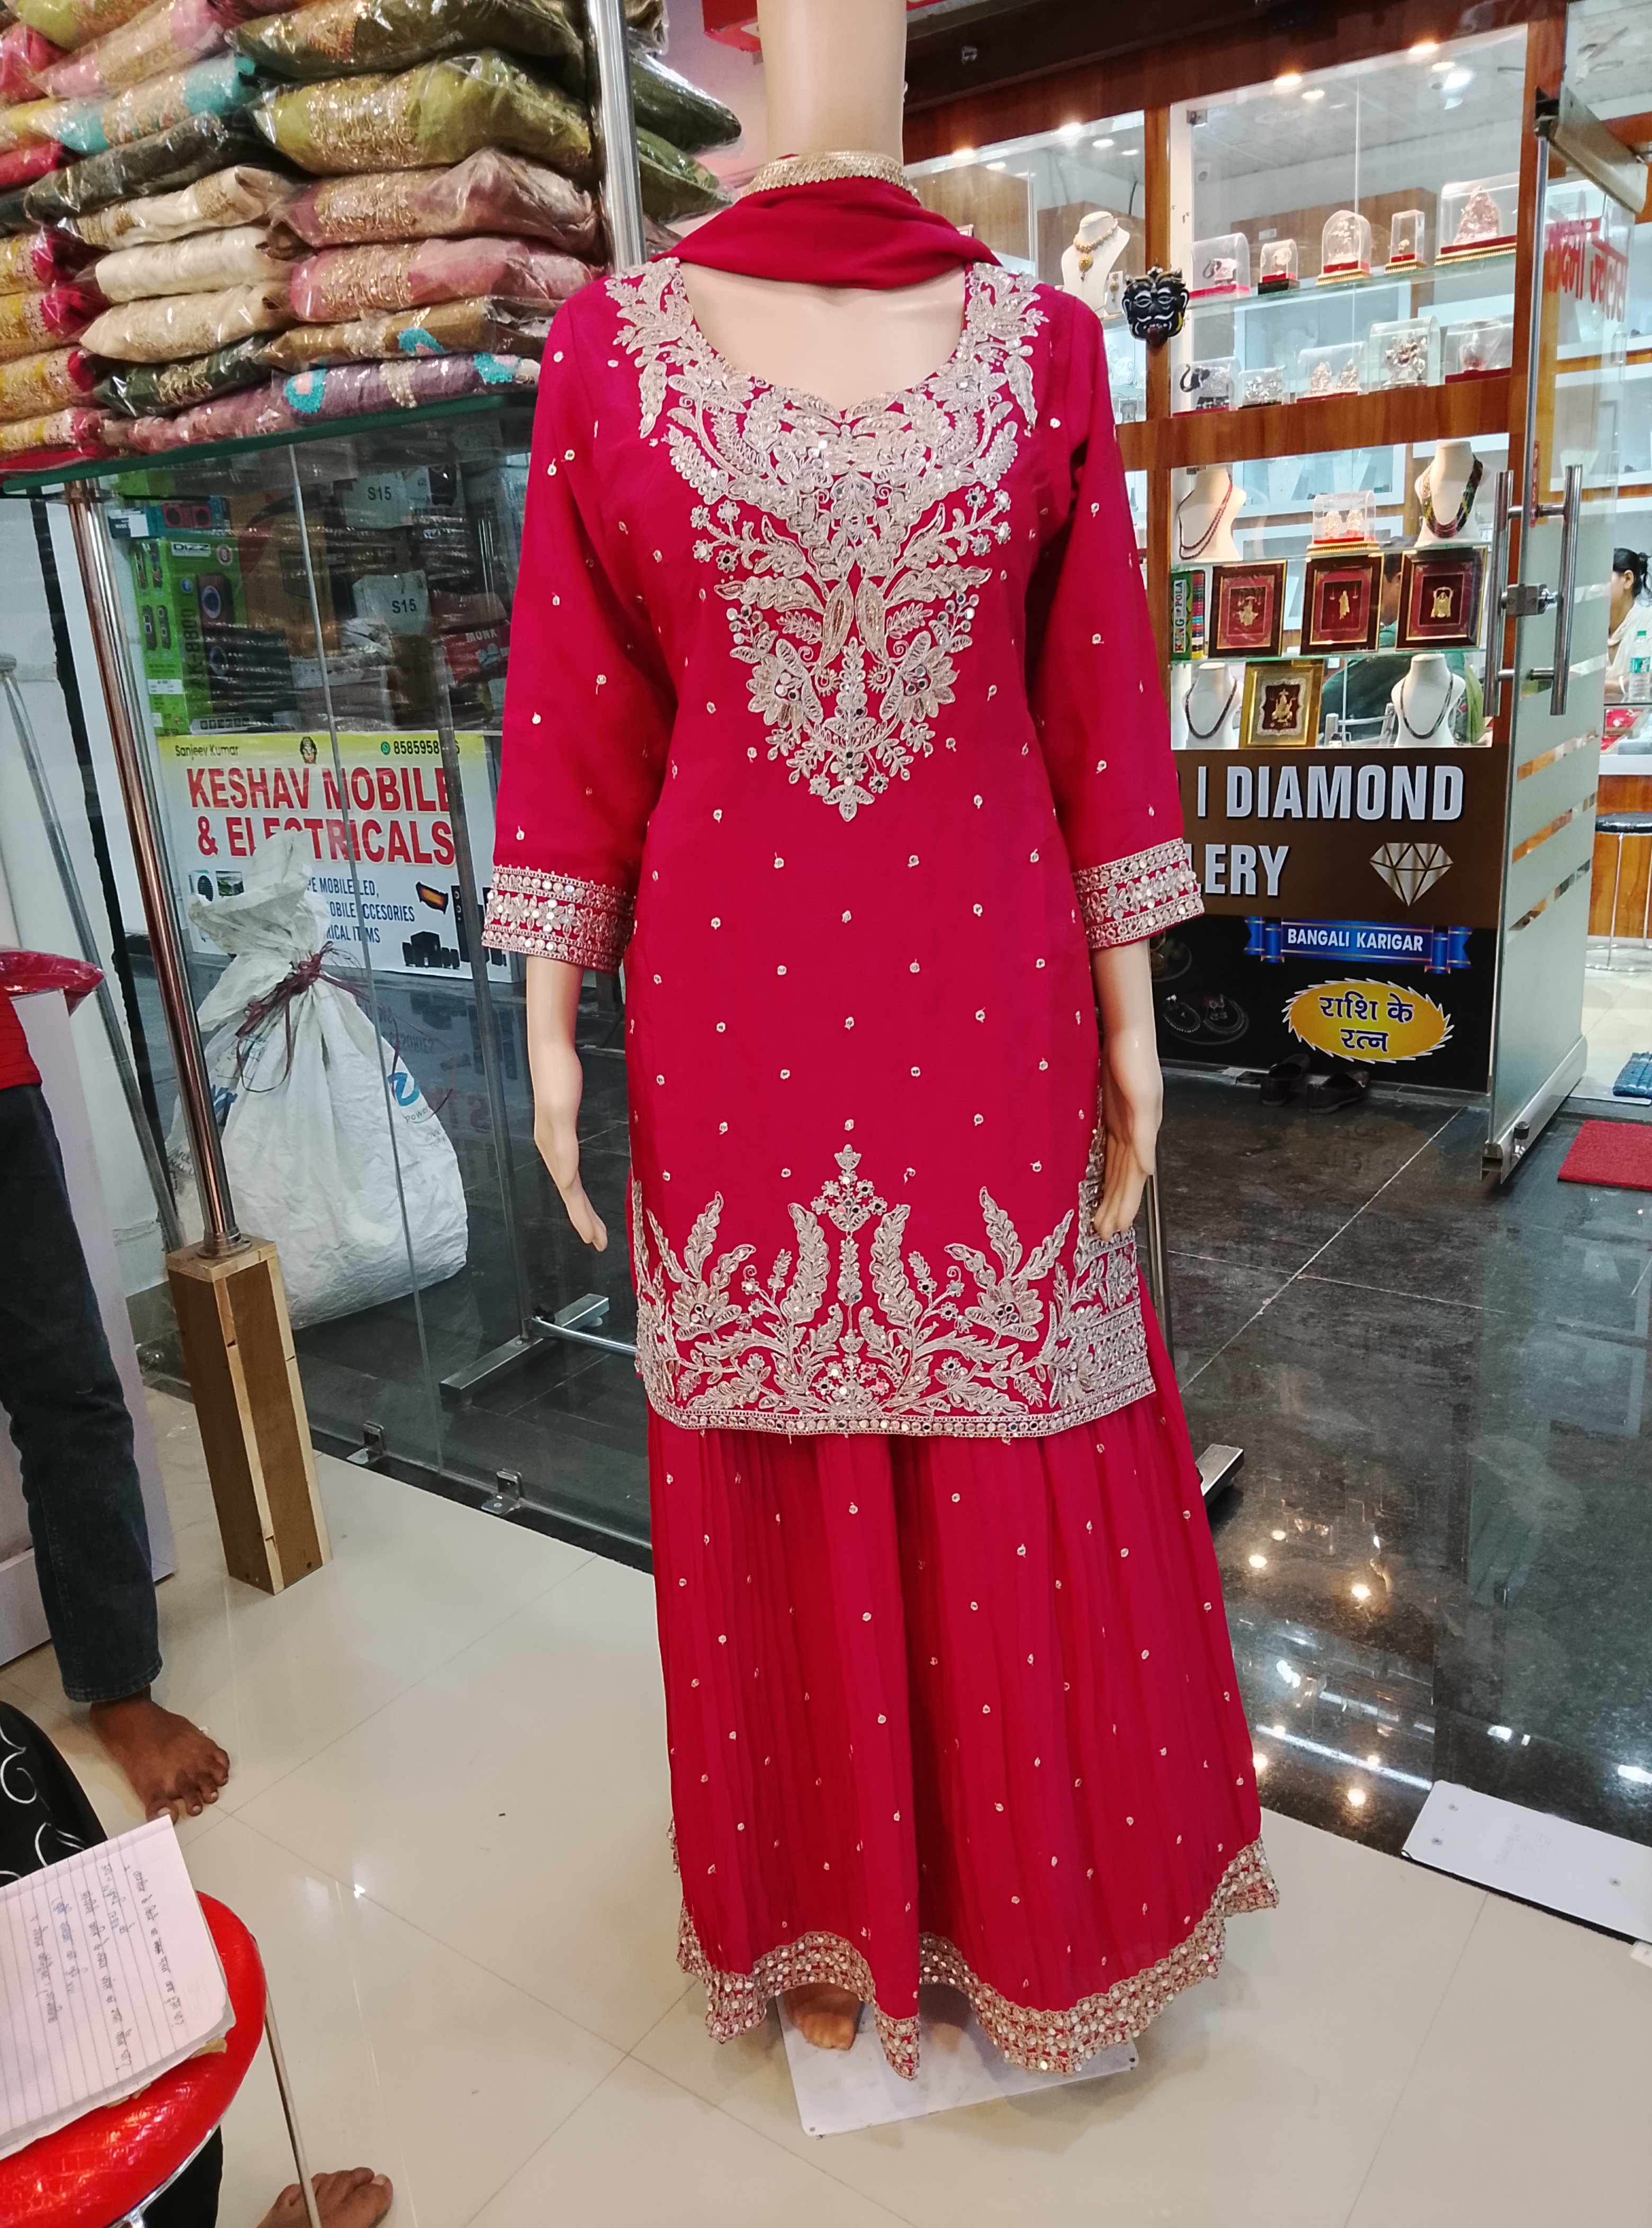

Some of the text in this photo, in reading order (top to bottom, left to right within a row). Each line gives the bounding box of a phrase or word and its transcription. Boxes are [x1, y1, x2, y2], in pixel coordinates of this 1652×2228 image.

[367, 486, 392, 501] S15
[392, 598, 417, 614] S15
[175, 744, 238, 760] Sanjeev Kumar
[187, 767, 450, 812] KESHAV MOBILE
[1226, 765, 1464, 820] DIAMOND
[197, 816, 219, 856] &
[319, 878, 355, 894] MOBILE
[328, 901, 415, 922] OBILE CCESORIES
[353, 926, 380, 943] ITMS
[1288, 929, 1423, 951] BANGALI KARIGAR
[1319, 990, 1414, 1023] राशि के
[1340, 1029, 1389, 1052] रत्न
